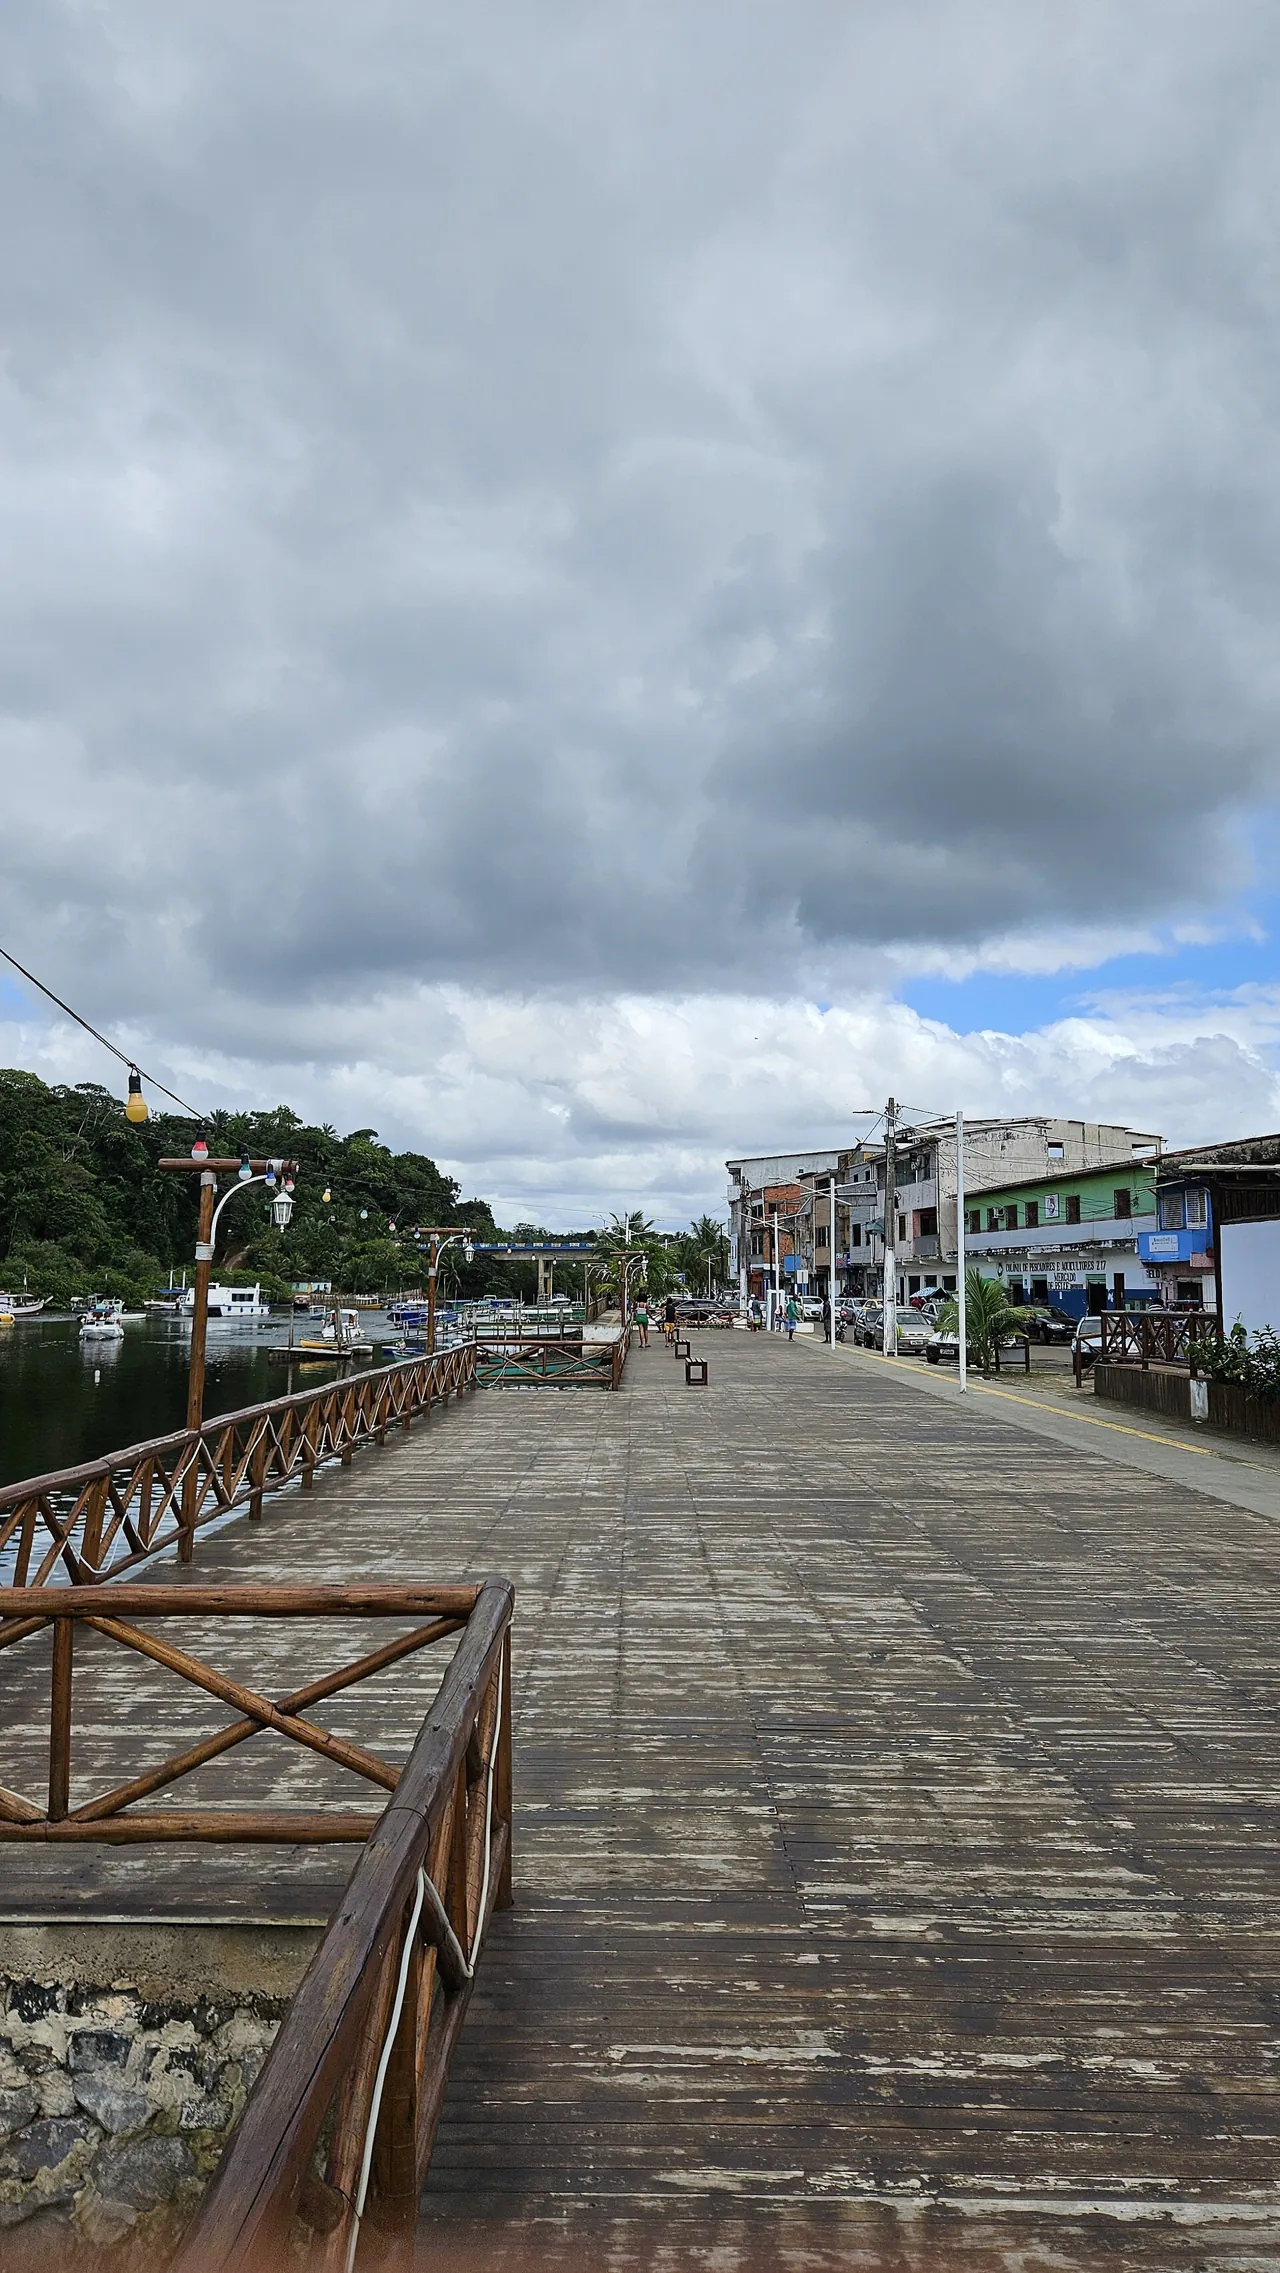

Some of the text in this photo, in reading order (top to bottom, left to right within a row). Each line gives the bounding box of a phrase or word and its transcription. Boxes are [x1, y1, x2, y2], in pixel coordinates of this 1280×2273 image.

[1023, 1263, 1028, 1272] DE
[1029, 1262, 1055, 1272] PESCADORES
[1062, 1261, 1094, 1271] AQUICULTORES
[1097, 1261, 1106, 1270] 217
[1054, 1272, 1076, 1282] MERCADO
